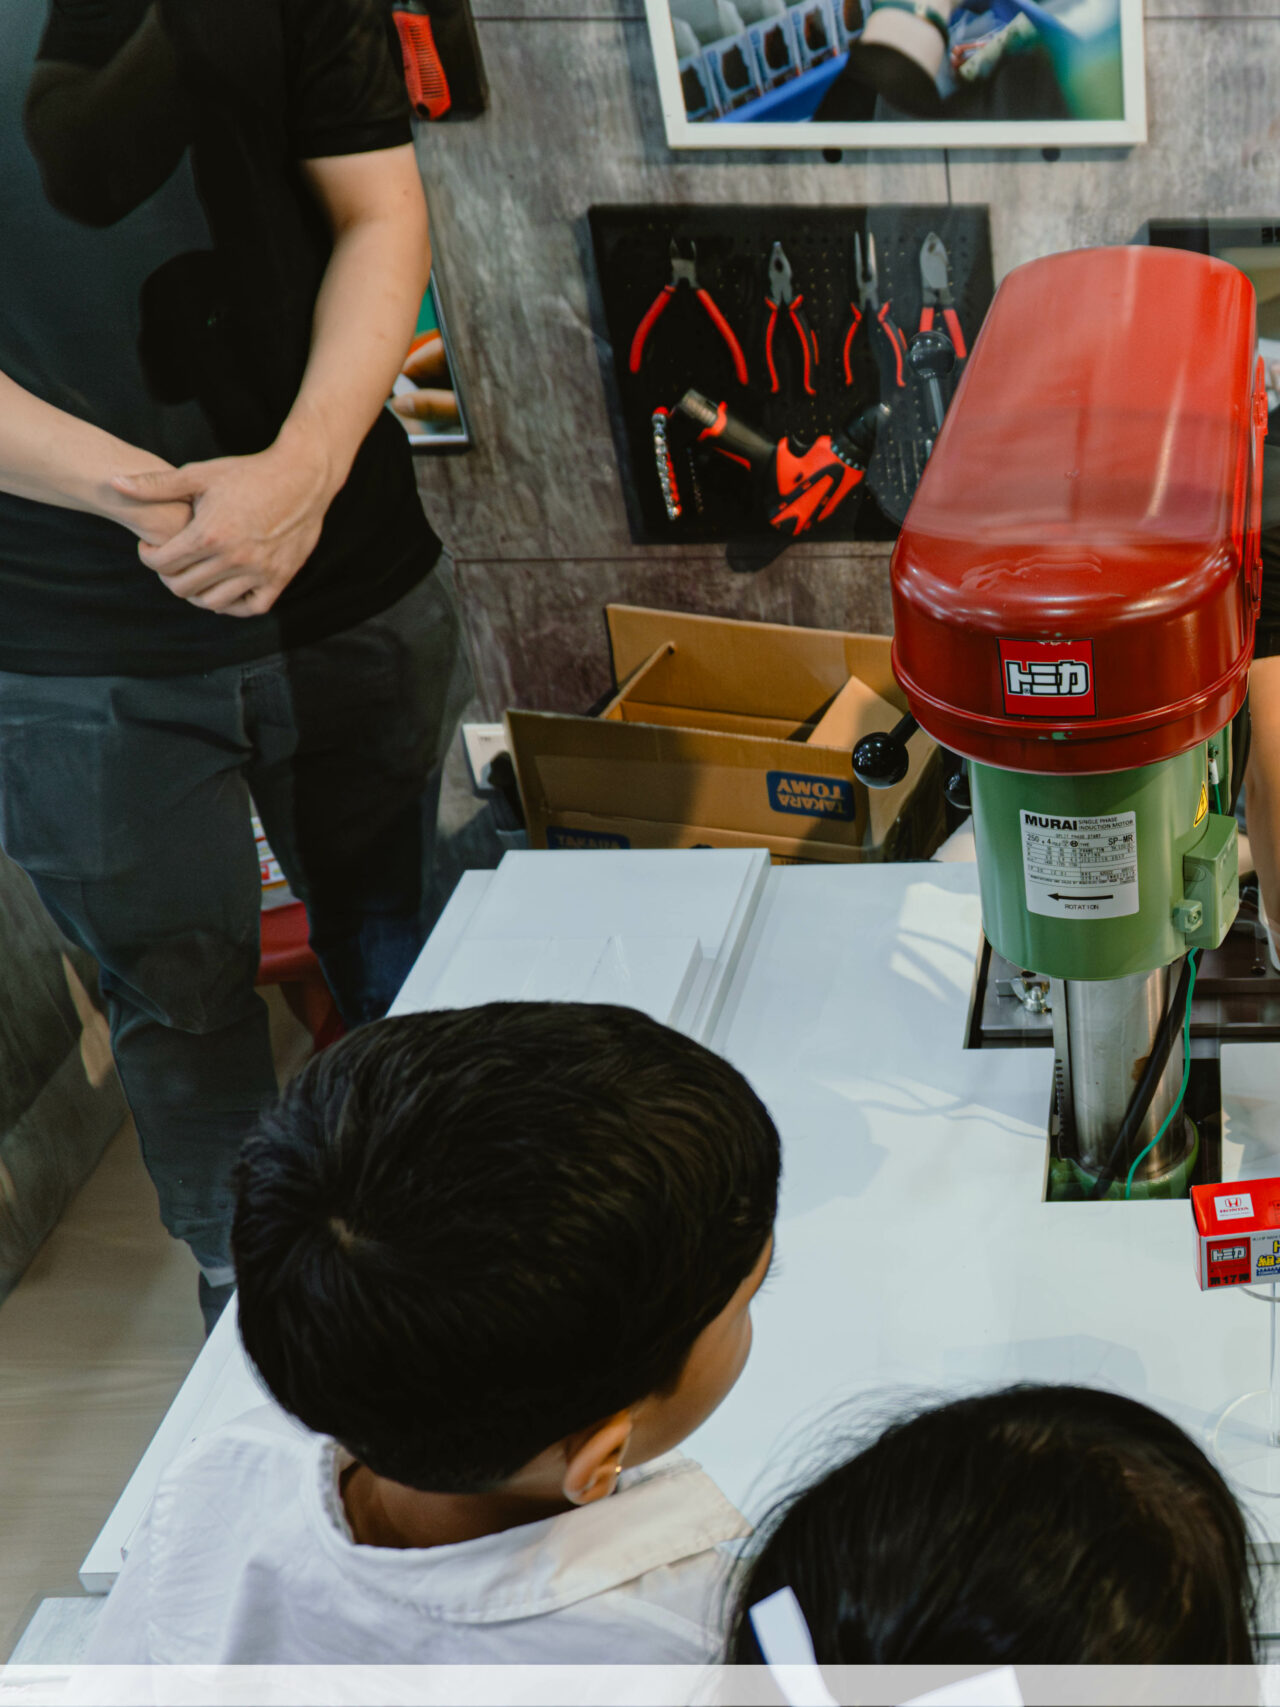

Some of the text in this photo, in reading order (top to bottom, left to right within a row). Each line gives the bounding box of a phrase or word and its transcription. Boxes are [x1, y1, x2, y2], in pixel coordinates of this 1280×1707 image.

[1004, 660, 1090, 697] トミカ
[776, 778, 845, 800] TOMY
[775, 794, 846, 814] TAKARA
[1024, 814, 1078, 830] MURAI
[1112, 820, 1134, 828] MOTOR
[1211, 1246, 1247, 1262] トミカ
